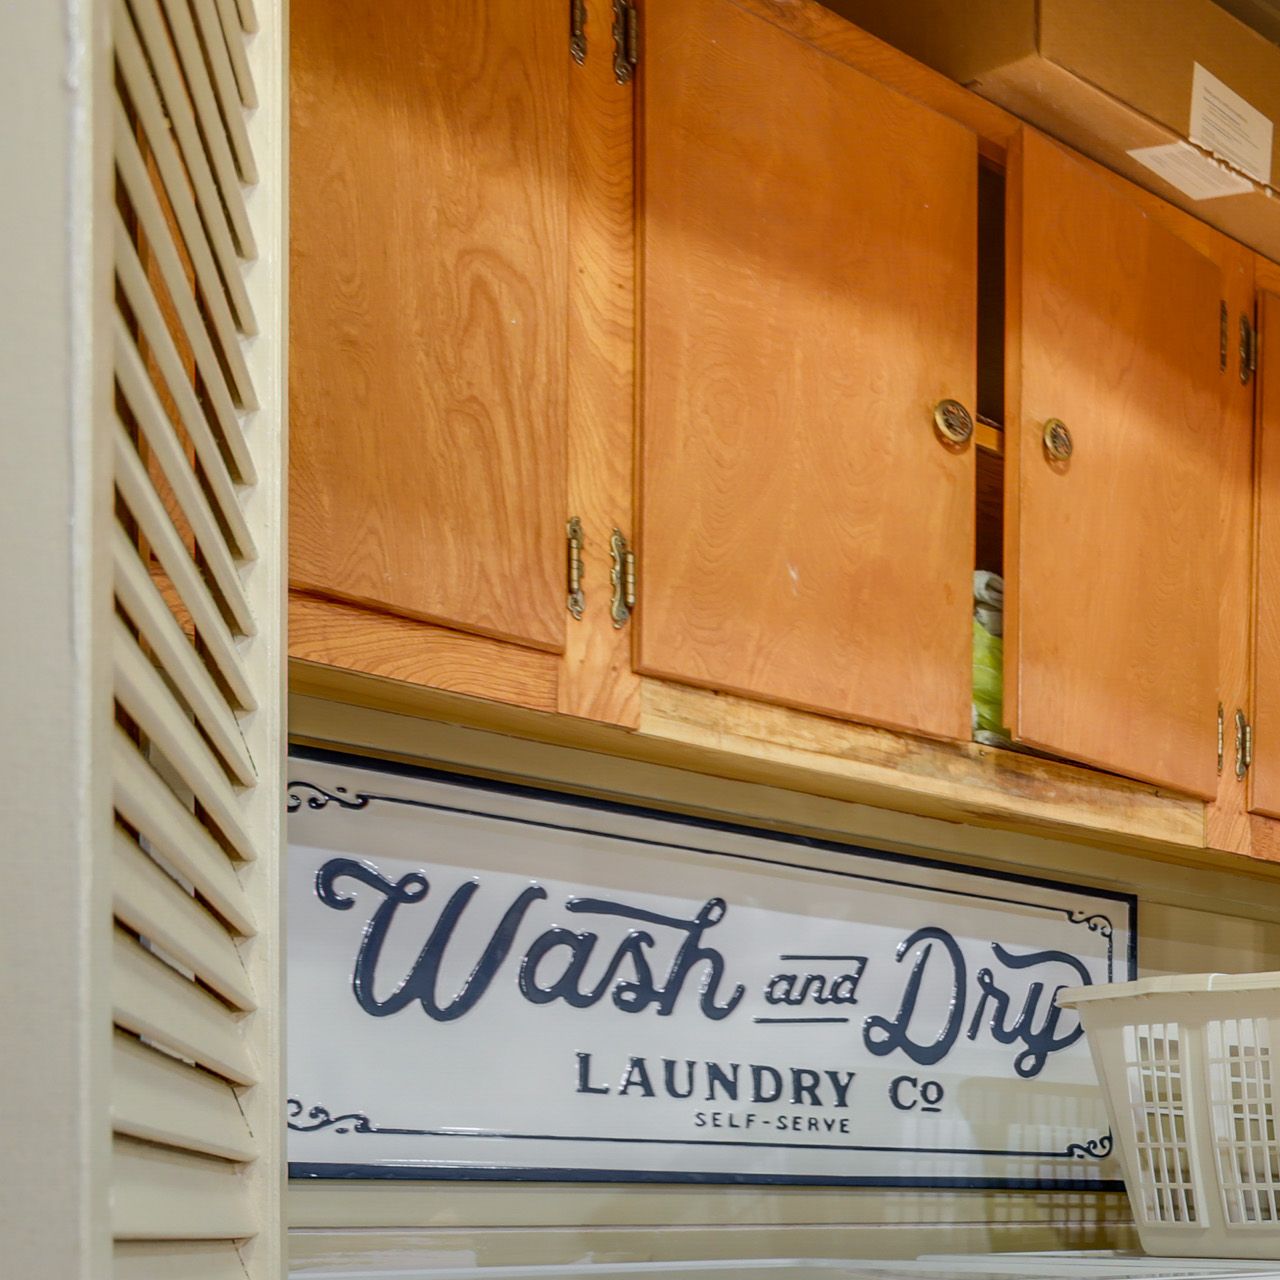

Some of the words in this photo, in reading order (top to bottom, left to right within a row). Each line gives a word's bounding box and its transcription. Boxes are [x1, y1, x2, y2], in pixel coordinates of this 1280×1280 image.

[315, 857, 745, 1021] Wash
[763, 954, 869, 1006] and
[862, 926, 1093, 1078] Dry
[575, 1051, 856, 1108] LAUNDRY
[694, 1111, 851, 1134] SELF-SERVE
